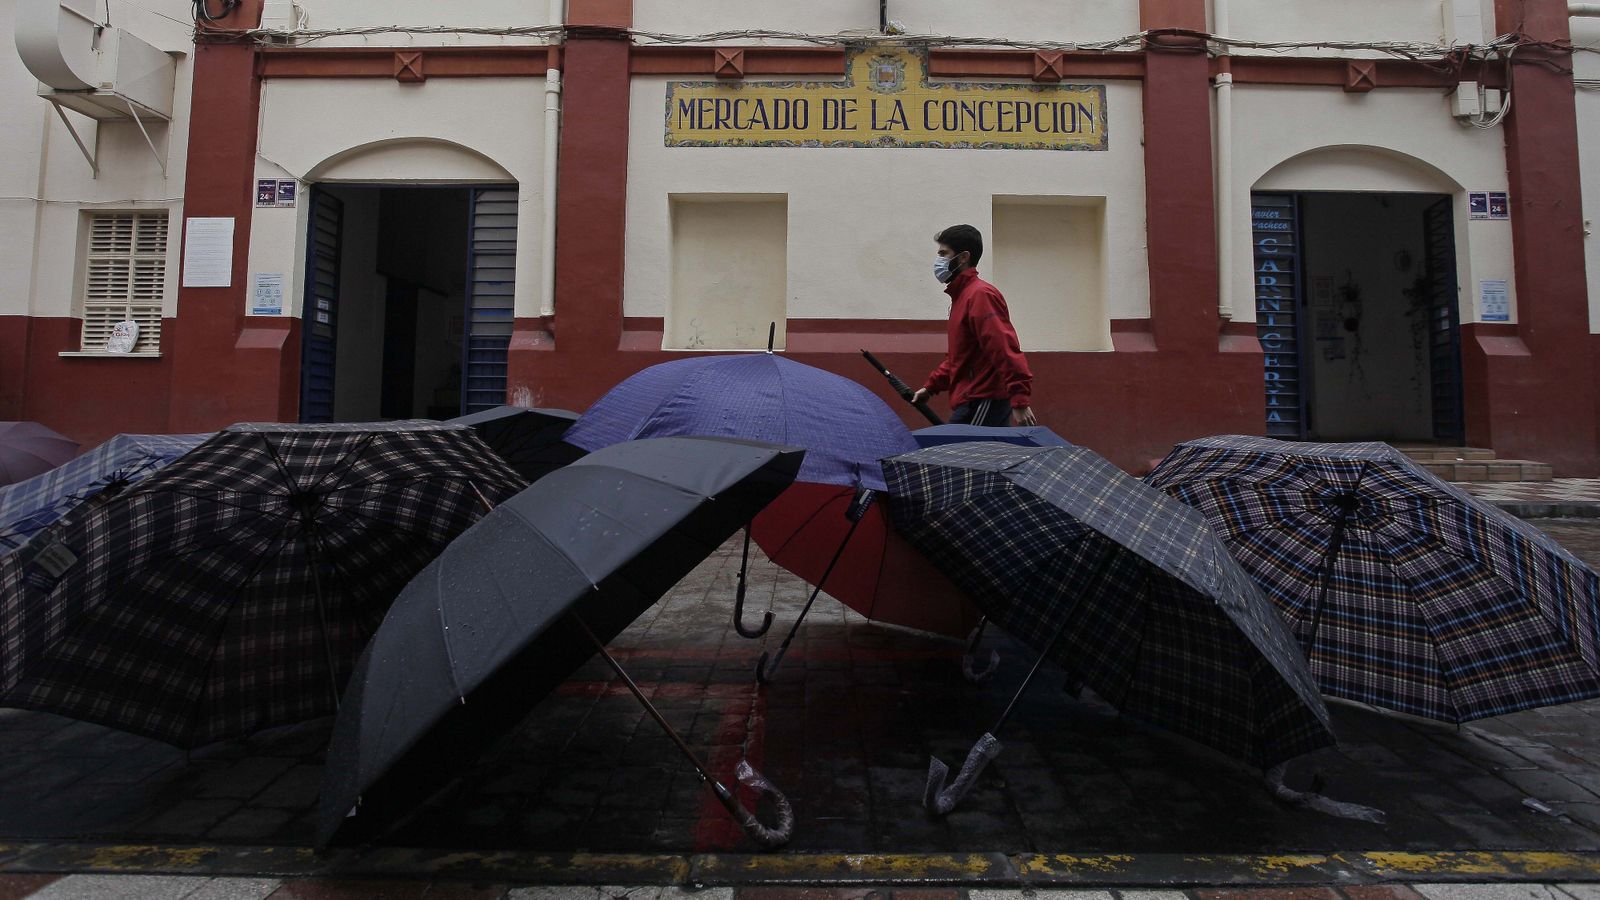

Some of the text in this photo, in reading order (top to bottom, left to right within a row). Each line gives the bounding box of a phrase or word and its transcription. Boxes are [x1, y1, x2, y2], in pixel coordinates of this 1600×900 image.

[678, 98, 1096, 134] MERCADO DE LA CONCEPCION
[1258, 238, 1285, 422] CARNICERIA
